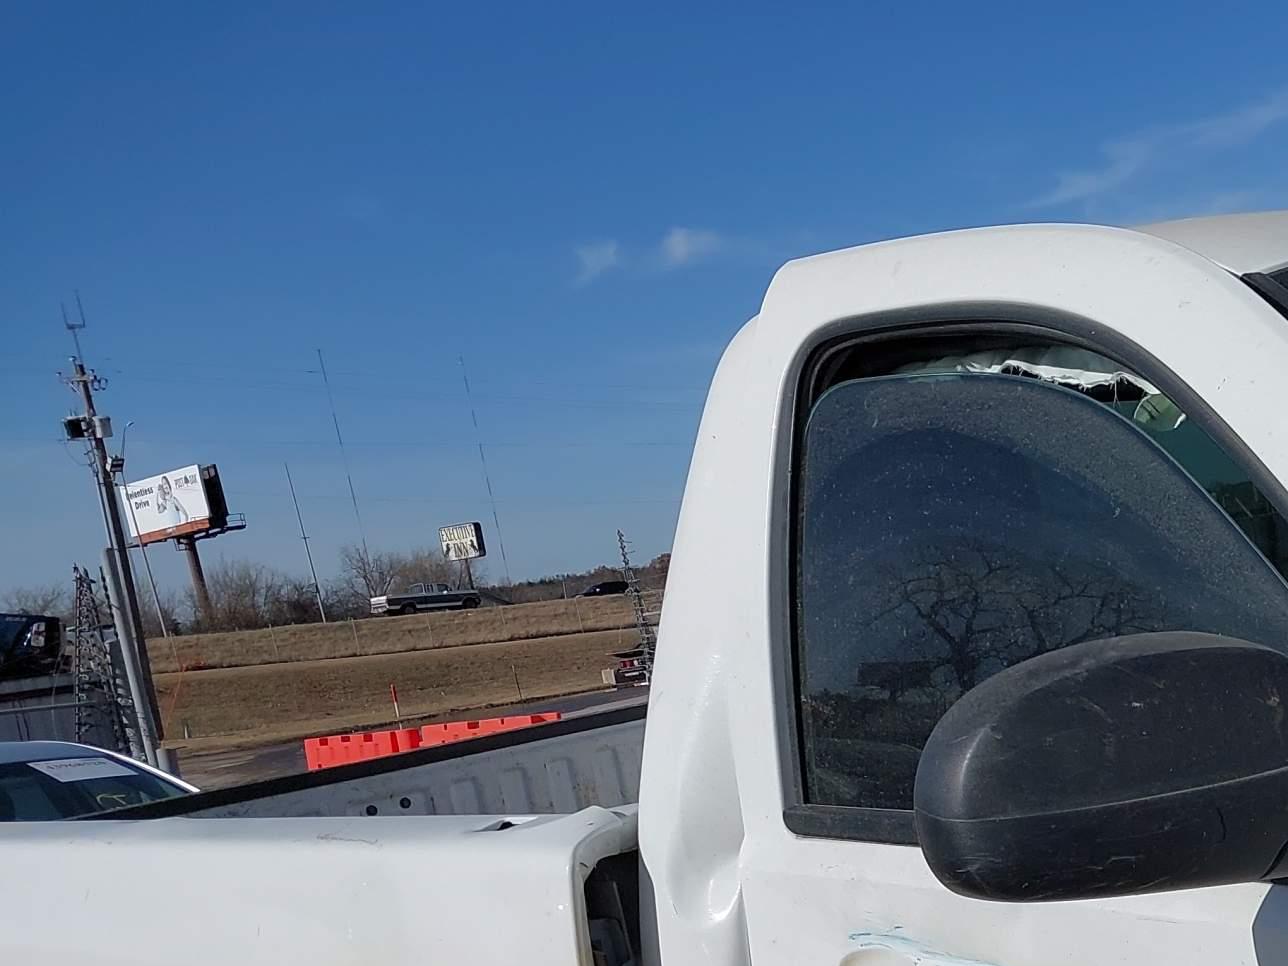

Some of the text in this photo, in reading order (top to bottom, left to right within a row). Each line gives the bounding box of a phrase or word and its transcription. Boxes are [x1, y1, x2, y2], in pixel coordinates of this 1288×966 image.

[134, 500, 150, 510] Drive
[440, 524, 475, 542] EXECUTIVE
[453, 541, 469, 558] INN
